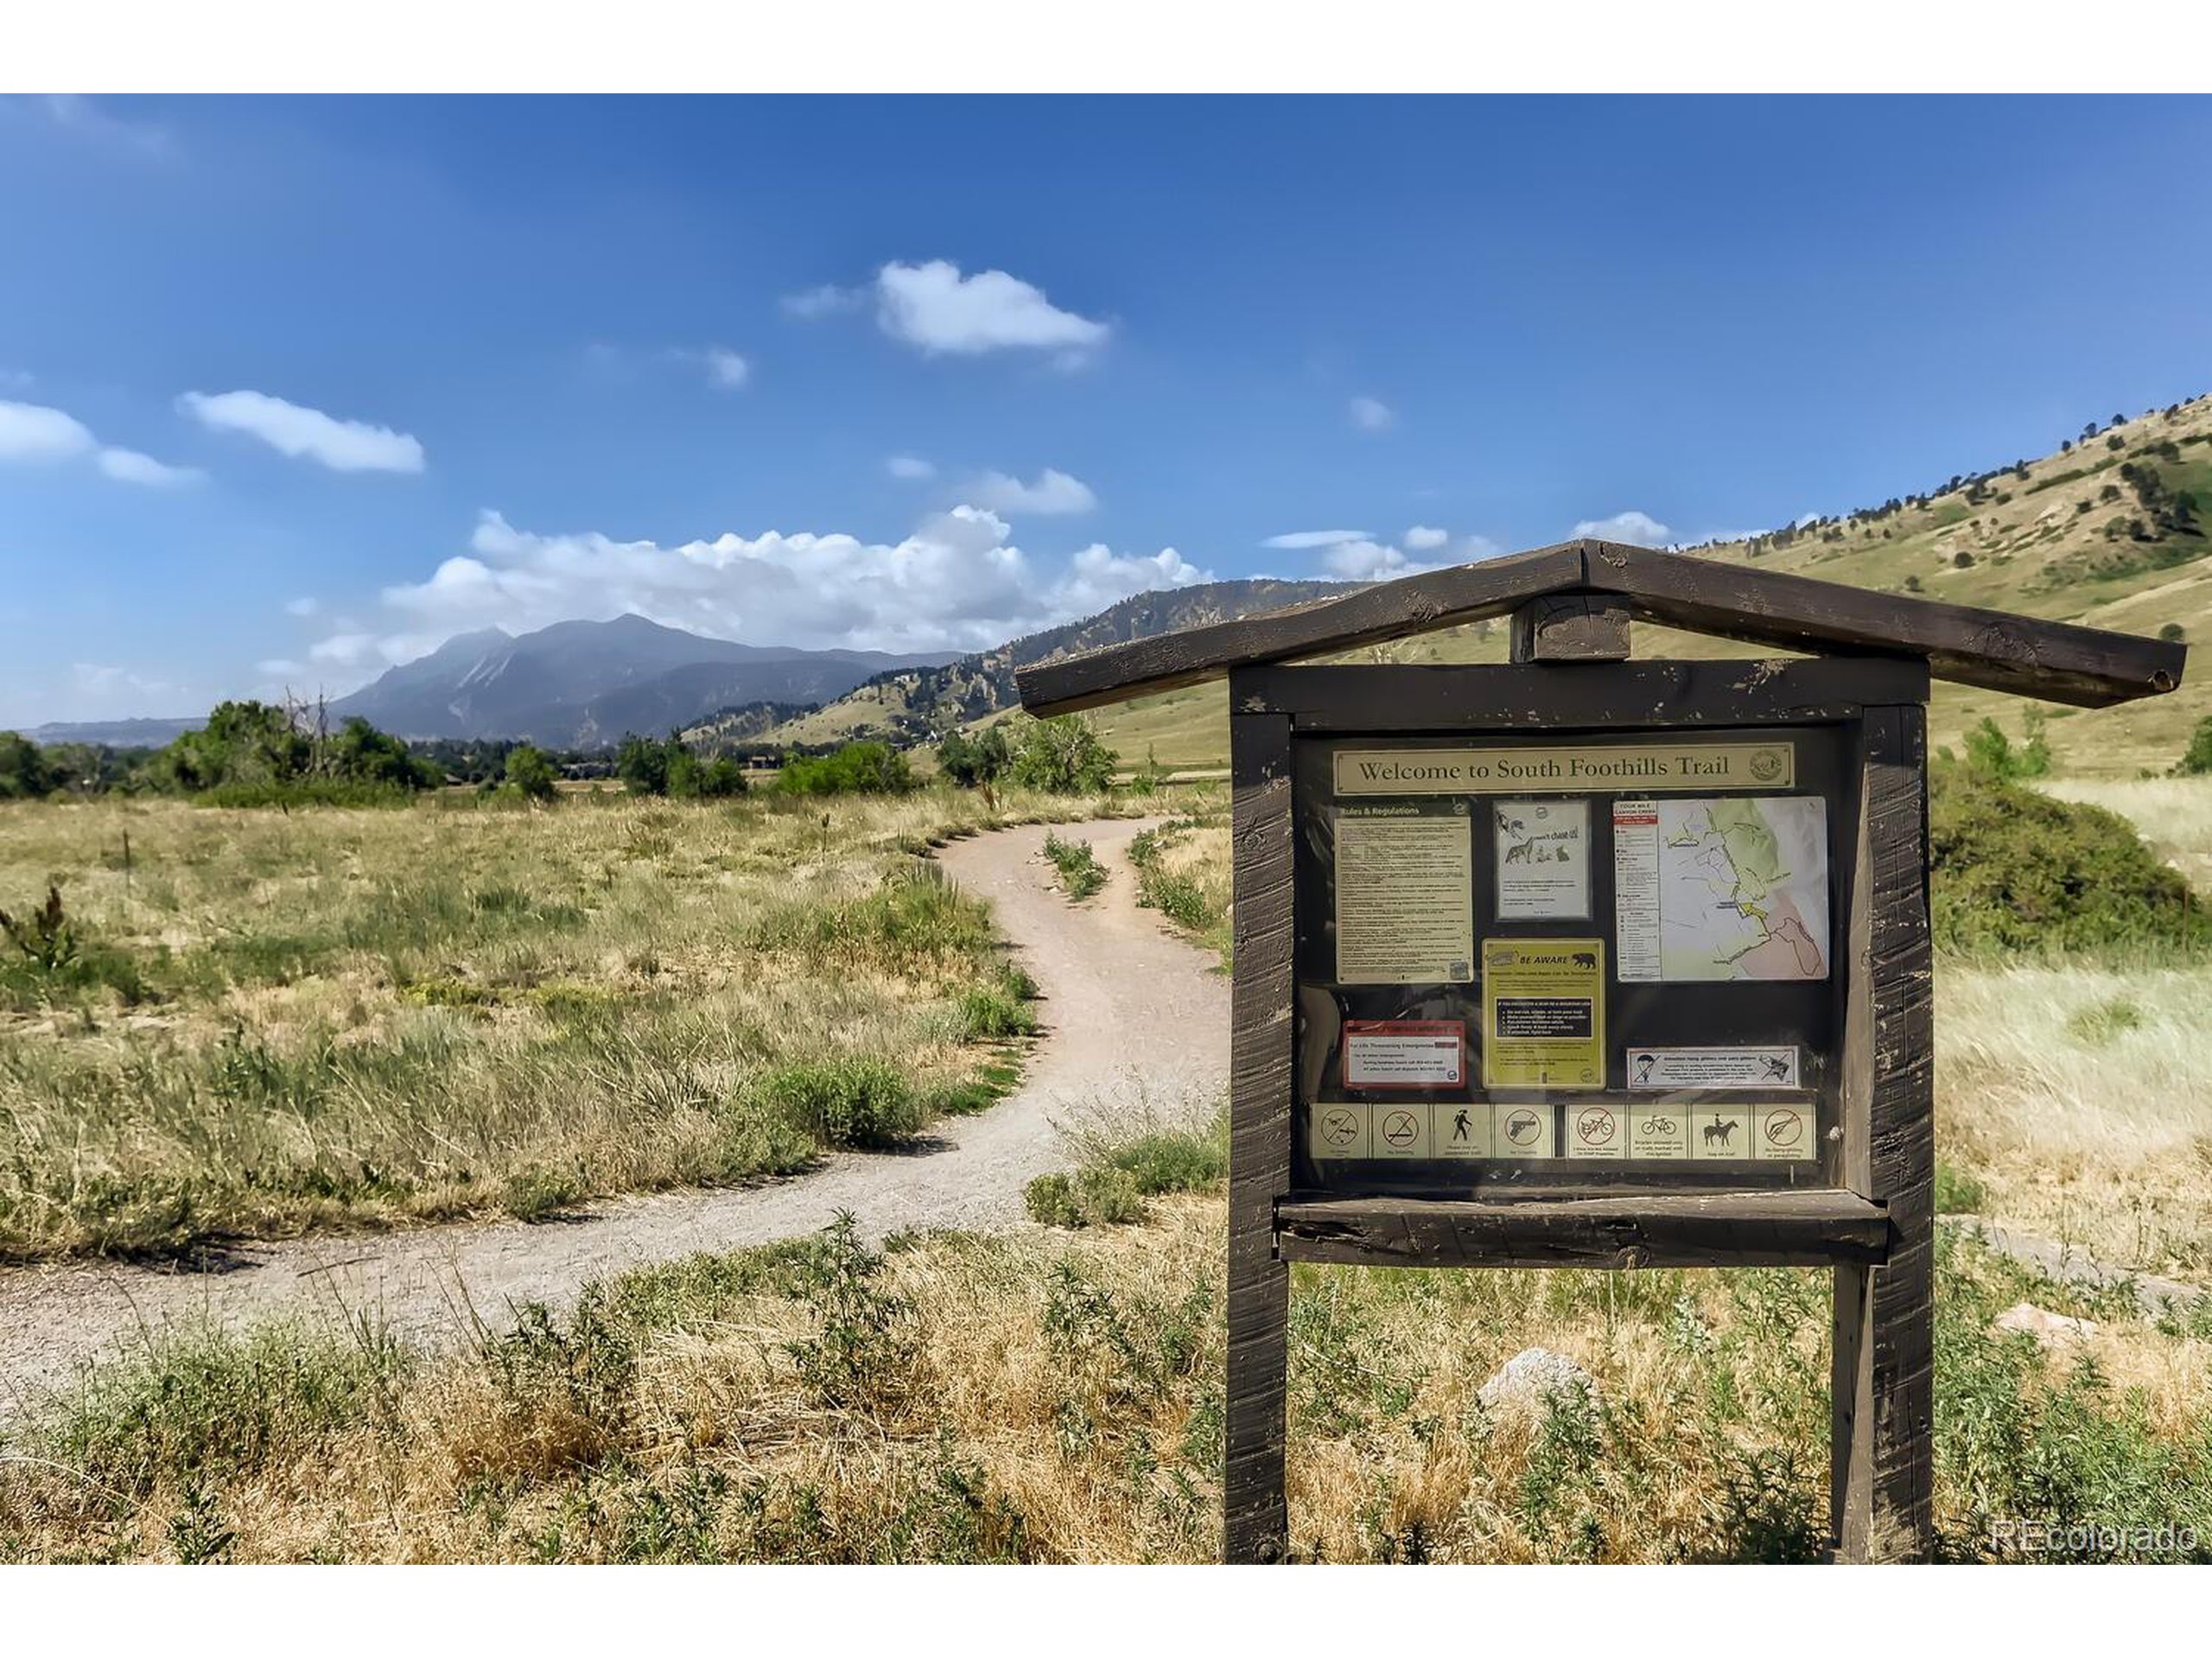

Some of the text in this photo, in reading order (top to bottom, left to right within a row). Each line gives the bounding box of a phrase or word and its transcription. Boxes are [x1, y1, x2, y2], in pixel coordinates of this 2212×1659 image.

[1359, 756, 1729, 780] Welcome to South Foothills Trail
[1372, 807, 1420, 817] Regulations
[1519, 956, 1568, 964] BE AWARE
